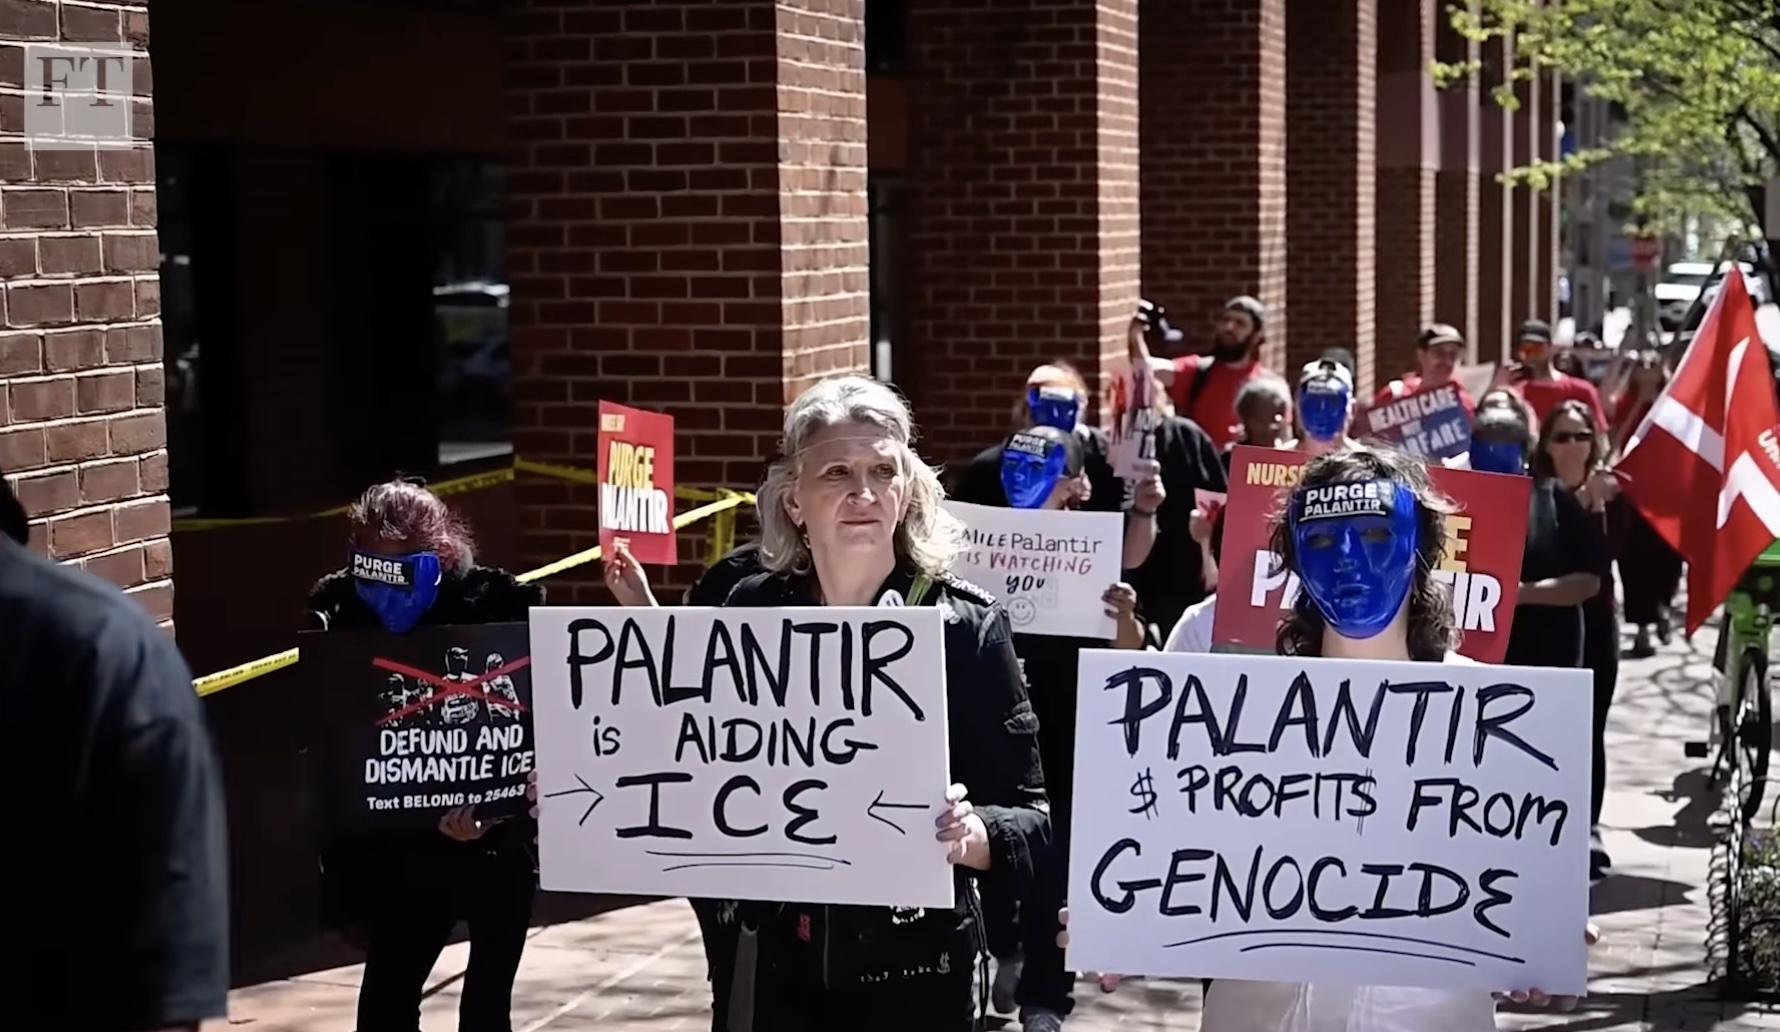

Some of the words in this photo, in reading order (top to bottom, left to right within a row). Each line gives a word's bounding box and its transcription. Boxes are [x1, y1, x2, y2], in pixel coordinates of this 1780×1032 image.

[608, 441, 655, 490] PURGE
[1304, 499, 1381, 517] PALANTIR
[1306, 483, 1378, 506] PURGE
[962, 528, 1007, 547] MILE
[1011, 533, 1102, 553] Palantir
[353, 554, 403, 575] PURGE
[353, 567, 405, 584] PALANTIR
[966, 552, 981, 565] IS
[990, 552, 1092, 575] WATCHING
[566, 615, 926, 721] PALANTIR
[1104, 666, 1560, 771] PALANTIR
[380, 728, 468, 756] DEFUND
[475, 724, 523, 751] AND
[593, 716, 621, 756] is
[675, 713, 878, 767] AIDING
[365, 754, 494, 784] DISMANTLE
[501, 750, 534, 778] ICE
[366, 796, 400, 810] Text
[403, 791, 464, 808] BELONG
[468, 792, 482, 804] to
[484, 784, 526, 802] 25463
[615, 772, 837, 844] ICE
[1406, 778, 1569, 846] FROM
[1090, 838, 1519, 938] GENOCIDE
